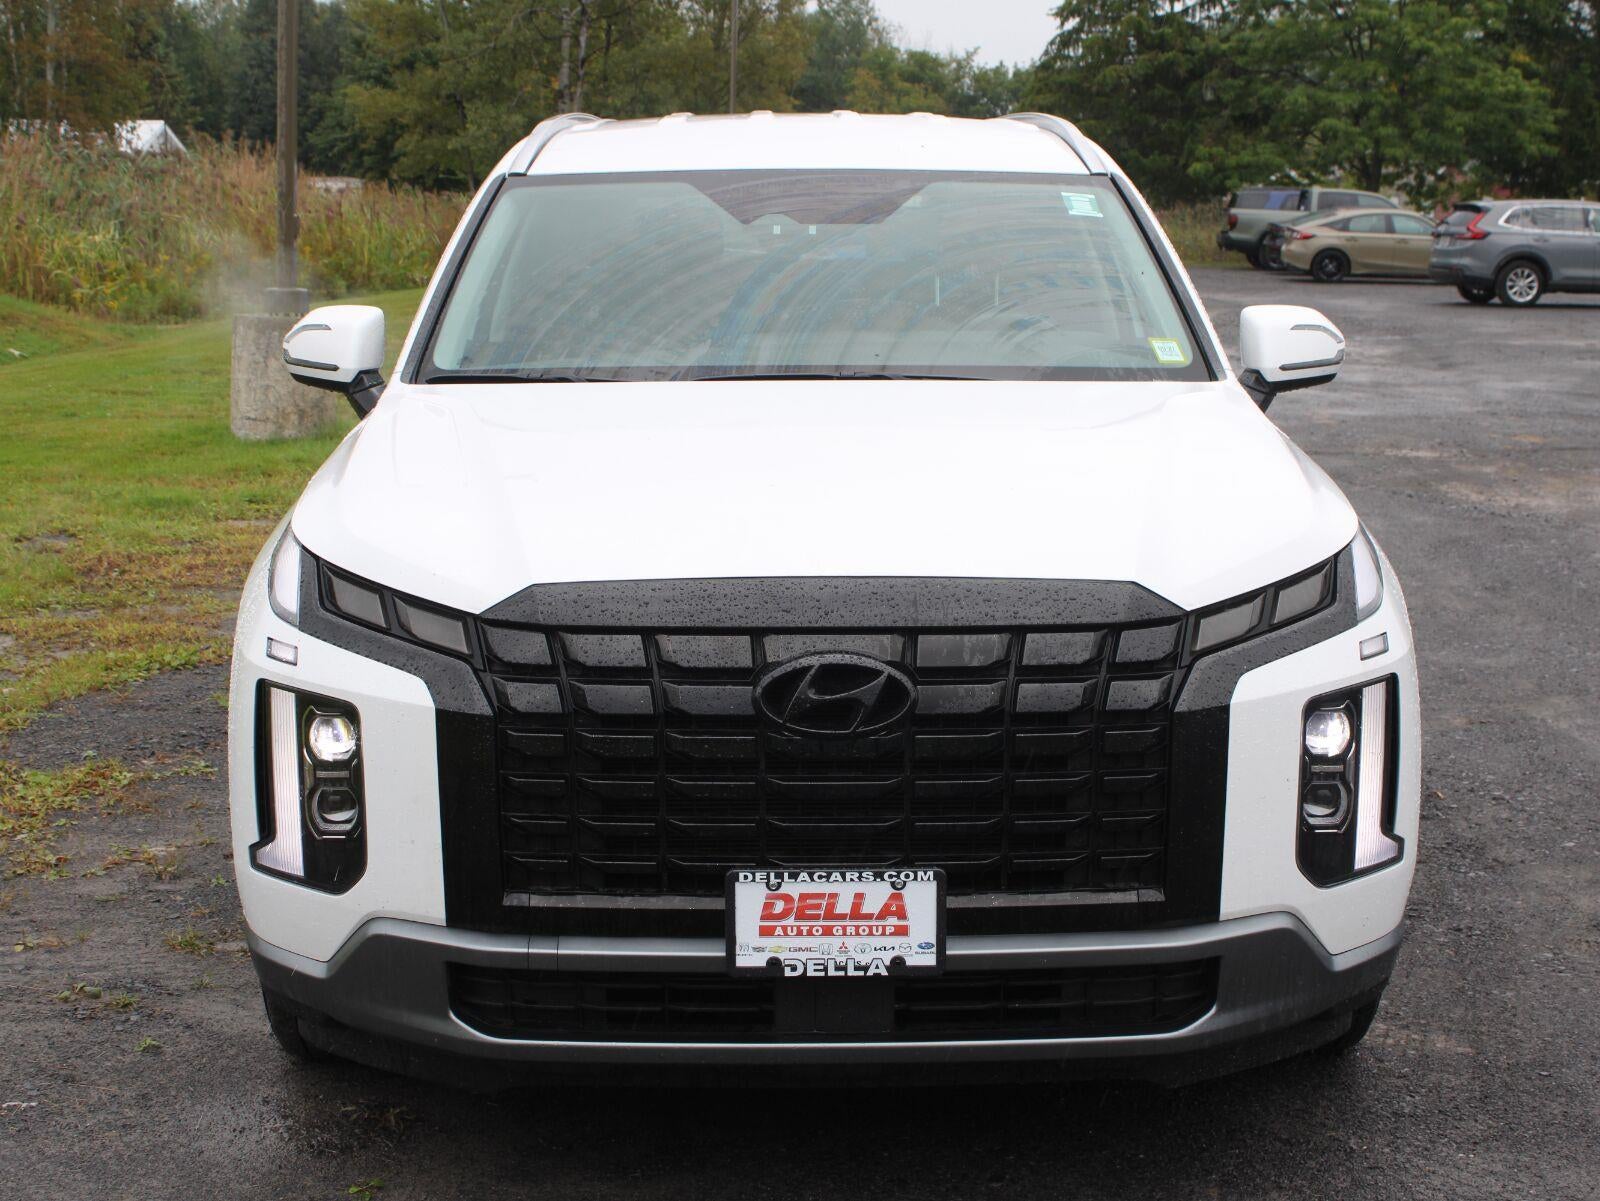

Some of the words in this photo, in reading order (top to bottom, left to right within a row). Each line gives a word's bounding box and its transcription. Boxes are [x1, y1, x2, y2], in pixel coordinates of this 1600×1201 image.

[738, 871, 934, 883] DELLACARS.COM
[759, 892, 909, 922] DELLA
[773, 925, 823, 936] AUTO
[832, 925, 895, 936] GROUP
[783, 958, 889, 977] DELLA
